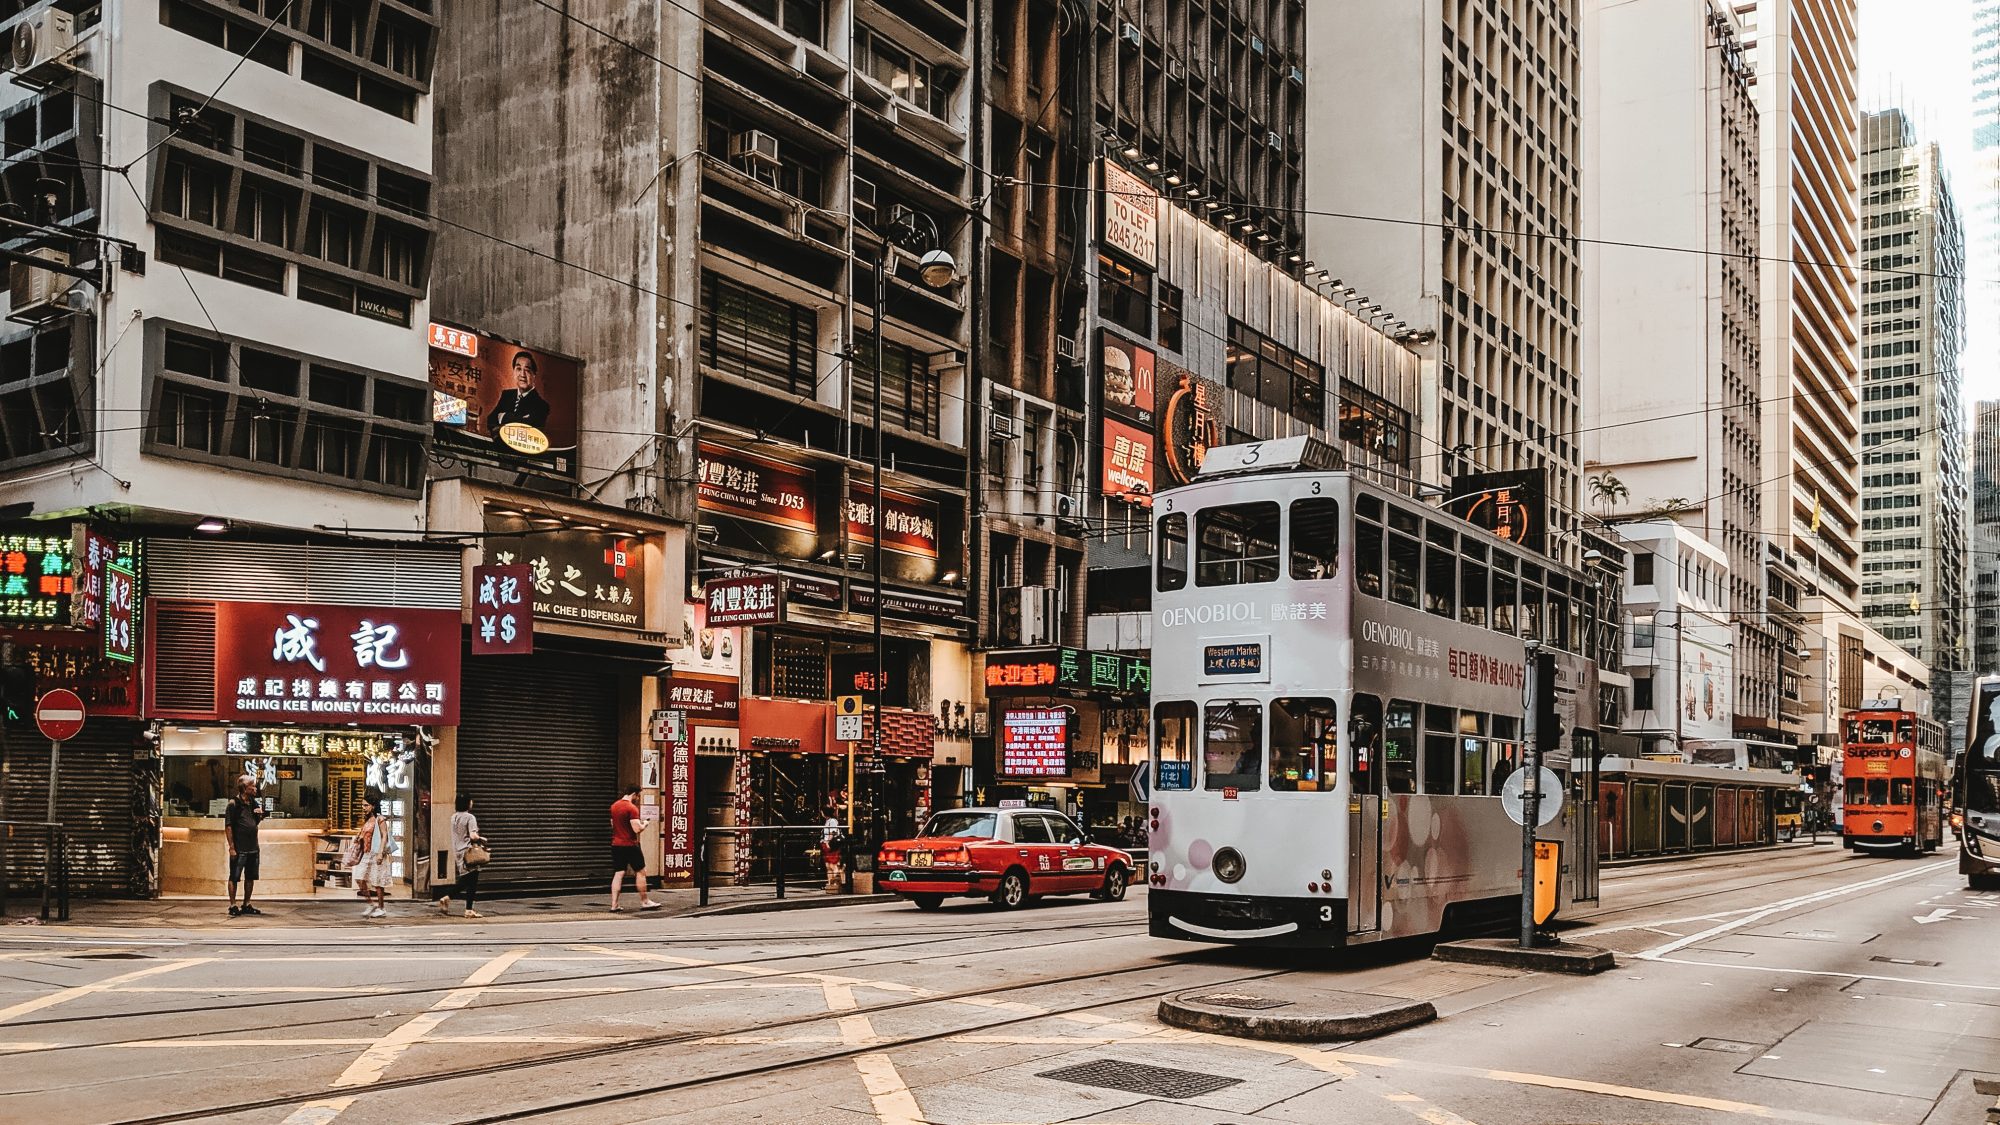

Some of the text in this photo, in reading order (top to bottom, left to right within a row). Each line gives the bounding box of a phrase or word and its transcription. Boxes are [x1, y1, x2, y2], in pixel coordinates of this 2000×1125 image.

[1114, 200, 1149, 233] TO LET
[1107, 218, 1154, 262] 2845 2317
[360, 300, 386, 314] IWKA
[1112, 436, 1147, 474] 惠康
[1242, 444, 1263, 465] 3
[1107, 469, 1150, 492] wellcome
[1311, 481, 1321, 495] 3
[703, 488, 720, 499] FUNG
[720, 491, 740, 503] CHINA
[740, 496, 757, 506] WARE
[761, 492, 804, 510] Since 1953
[1166, 499, 1173, 511] 3
[885, 509, 934, 540] 創富珍藏
[479, 575, 521, 609] 成記
[594, 584, 634, 605] 大藥房
[710, 583, 775, 613] 利豐瓷莊
[553, 604, 579, 617] CHEE
[580, 608, 638, 624] DISPENSARY
[710, 612, 775, 623] LEE FUNG CHINA WARE
[1162, 602, 1261, 628] OENOBIOL
[1271, 601, 1327, 621] 歐諾美
[273, 615, 408, 673] 成記
[1362, 620, 1414, 651] OENOBIOL
[1208, 646, 1260, 656] Western Market
[986, 662, 1056, 687] 歡迎查詢
[236, 678, 443, 701] 成記找換有限公司
[670, 687, 714, 704] 利豐瓷莊
[236, 700, 442, 715] SHING KEE MONEY EXCHANGE
[723, 701, 737, 709] 1953
[1872, 700, 1888, 708] 29
[852, 717, 858, 726] 7
[852, 730, 858, 738] 7
[1847, 747, 1900, 760] Superdry
[665, 853, 693, 869] 專賣店
[1320, 906, 1333, 922] 3
